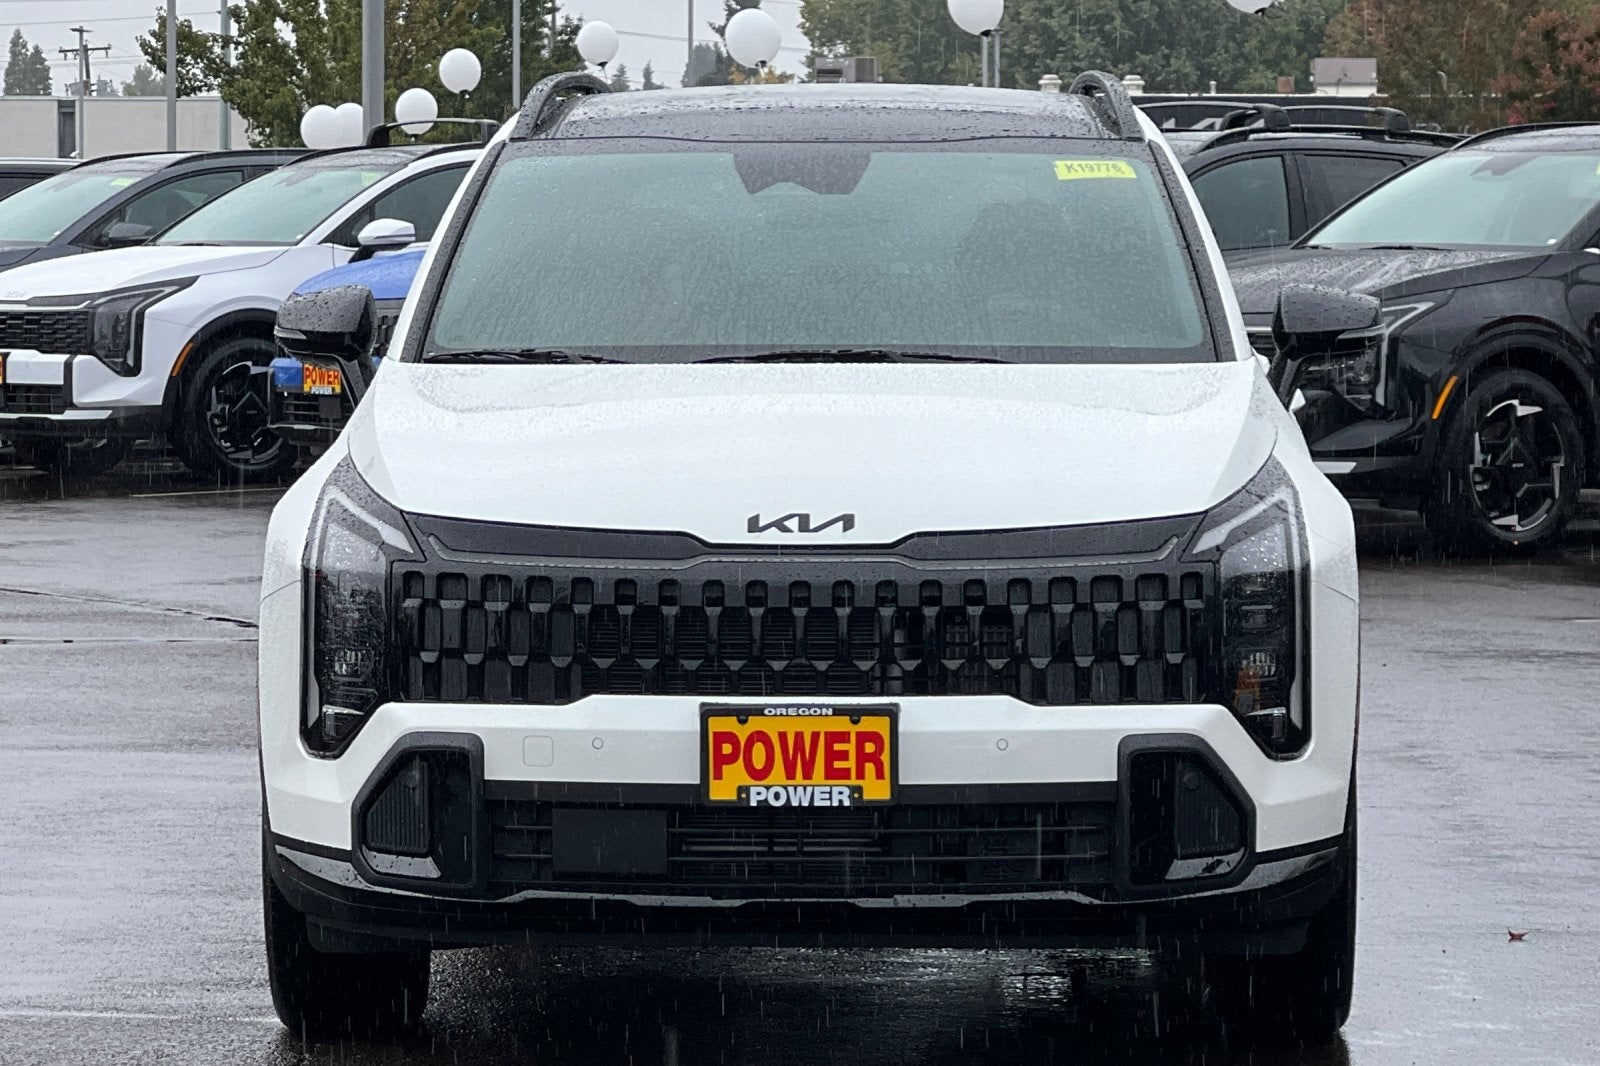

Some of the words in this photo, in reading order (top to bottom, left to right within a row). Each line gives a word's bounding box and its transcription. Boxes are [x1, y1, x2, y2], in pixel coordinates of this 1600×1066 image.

[304, 366, 340, 385] POWER
[747, 513, 855, 533] KIA
[764, 707, 833, 716] OREGON
[712, 730, 886, 781] POWER
[750, 786, 850, 807] POWER
